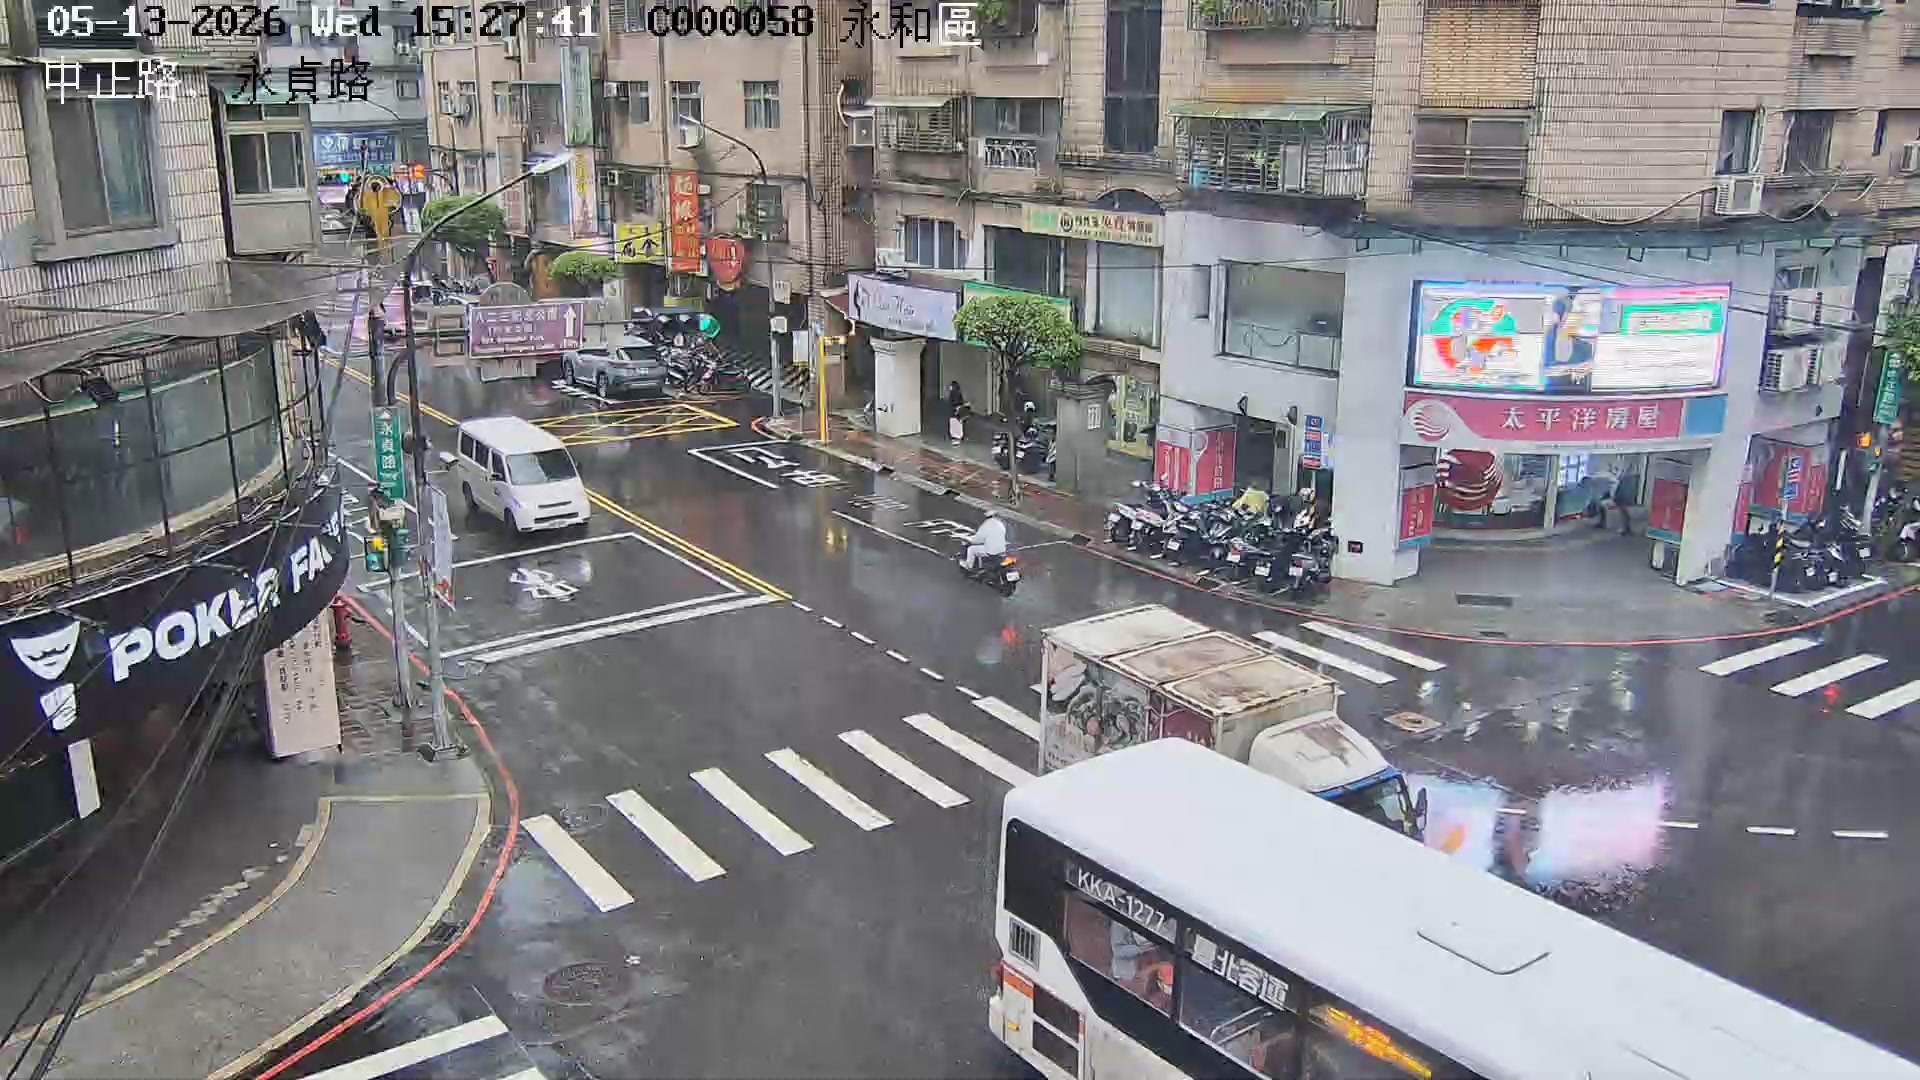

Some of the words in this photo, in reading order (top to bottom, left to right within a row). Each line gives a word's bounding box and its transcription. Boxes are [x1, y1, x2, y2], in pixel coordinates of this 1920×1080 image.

[1500, 403, 1661, 433] 太平洋房屋
[108, 567, 282, 683] POKER
[1078, 867, 1165, 934] KKA-1277
